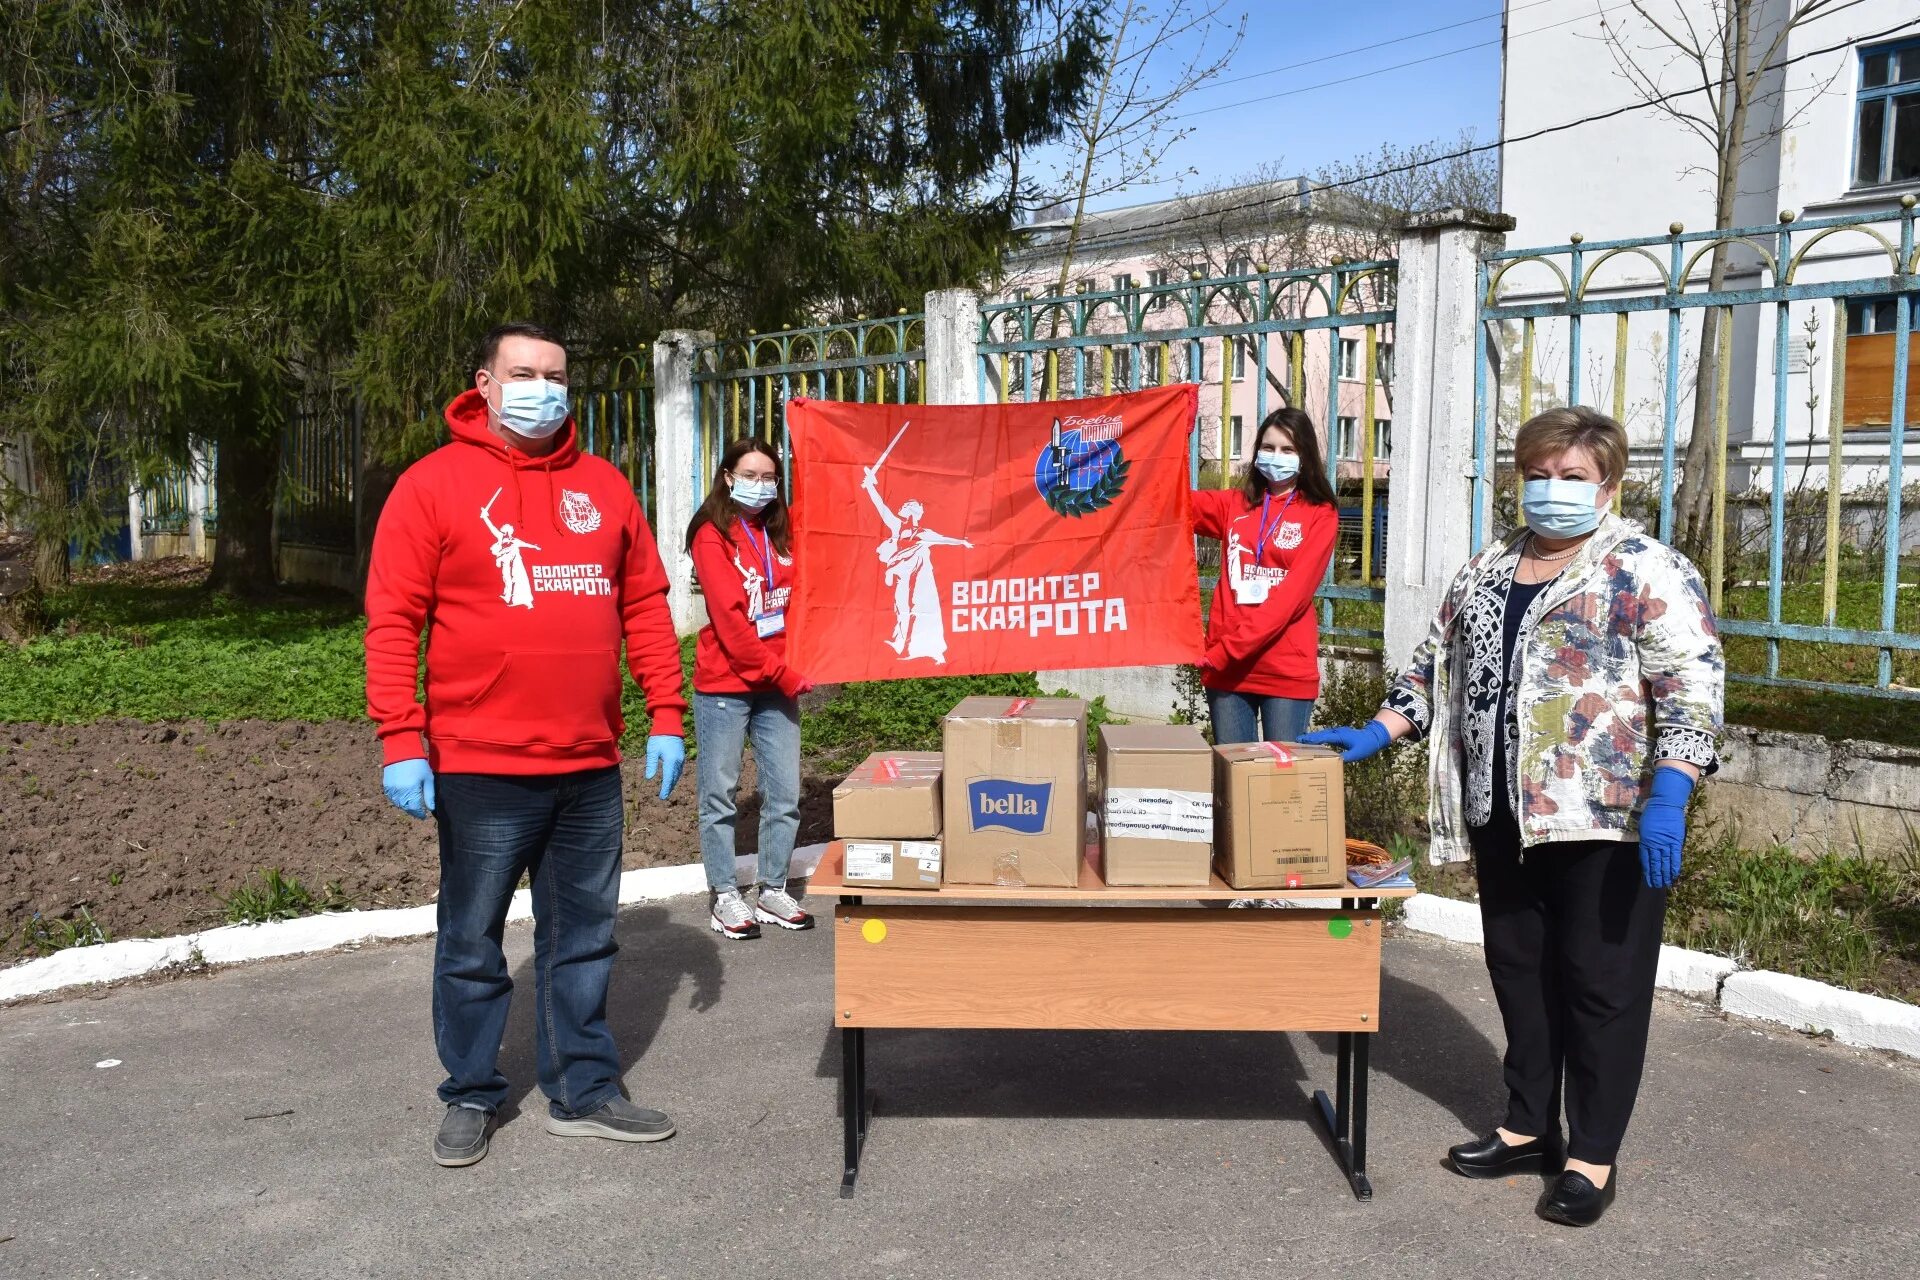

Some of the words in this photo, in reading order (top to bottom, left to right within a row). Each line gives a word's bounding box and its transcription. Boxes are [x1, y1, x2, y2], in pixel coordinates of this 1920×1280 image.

[1062, 414, 1123, 426] Боевое
[532, 564, 603, 578] ВОЛОНТЕР
[952, 572, 1100, 606] ВОЛОНТЕР
[979, 792, 1038, 816] bella
